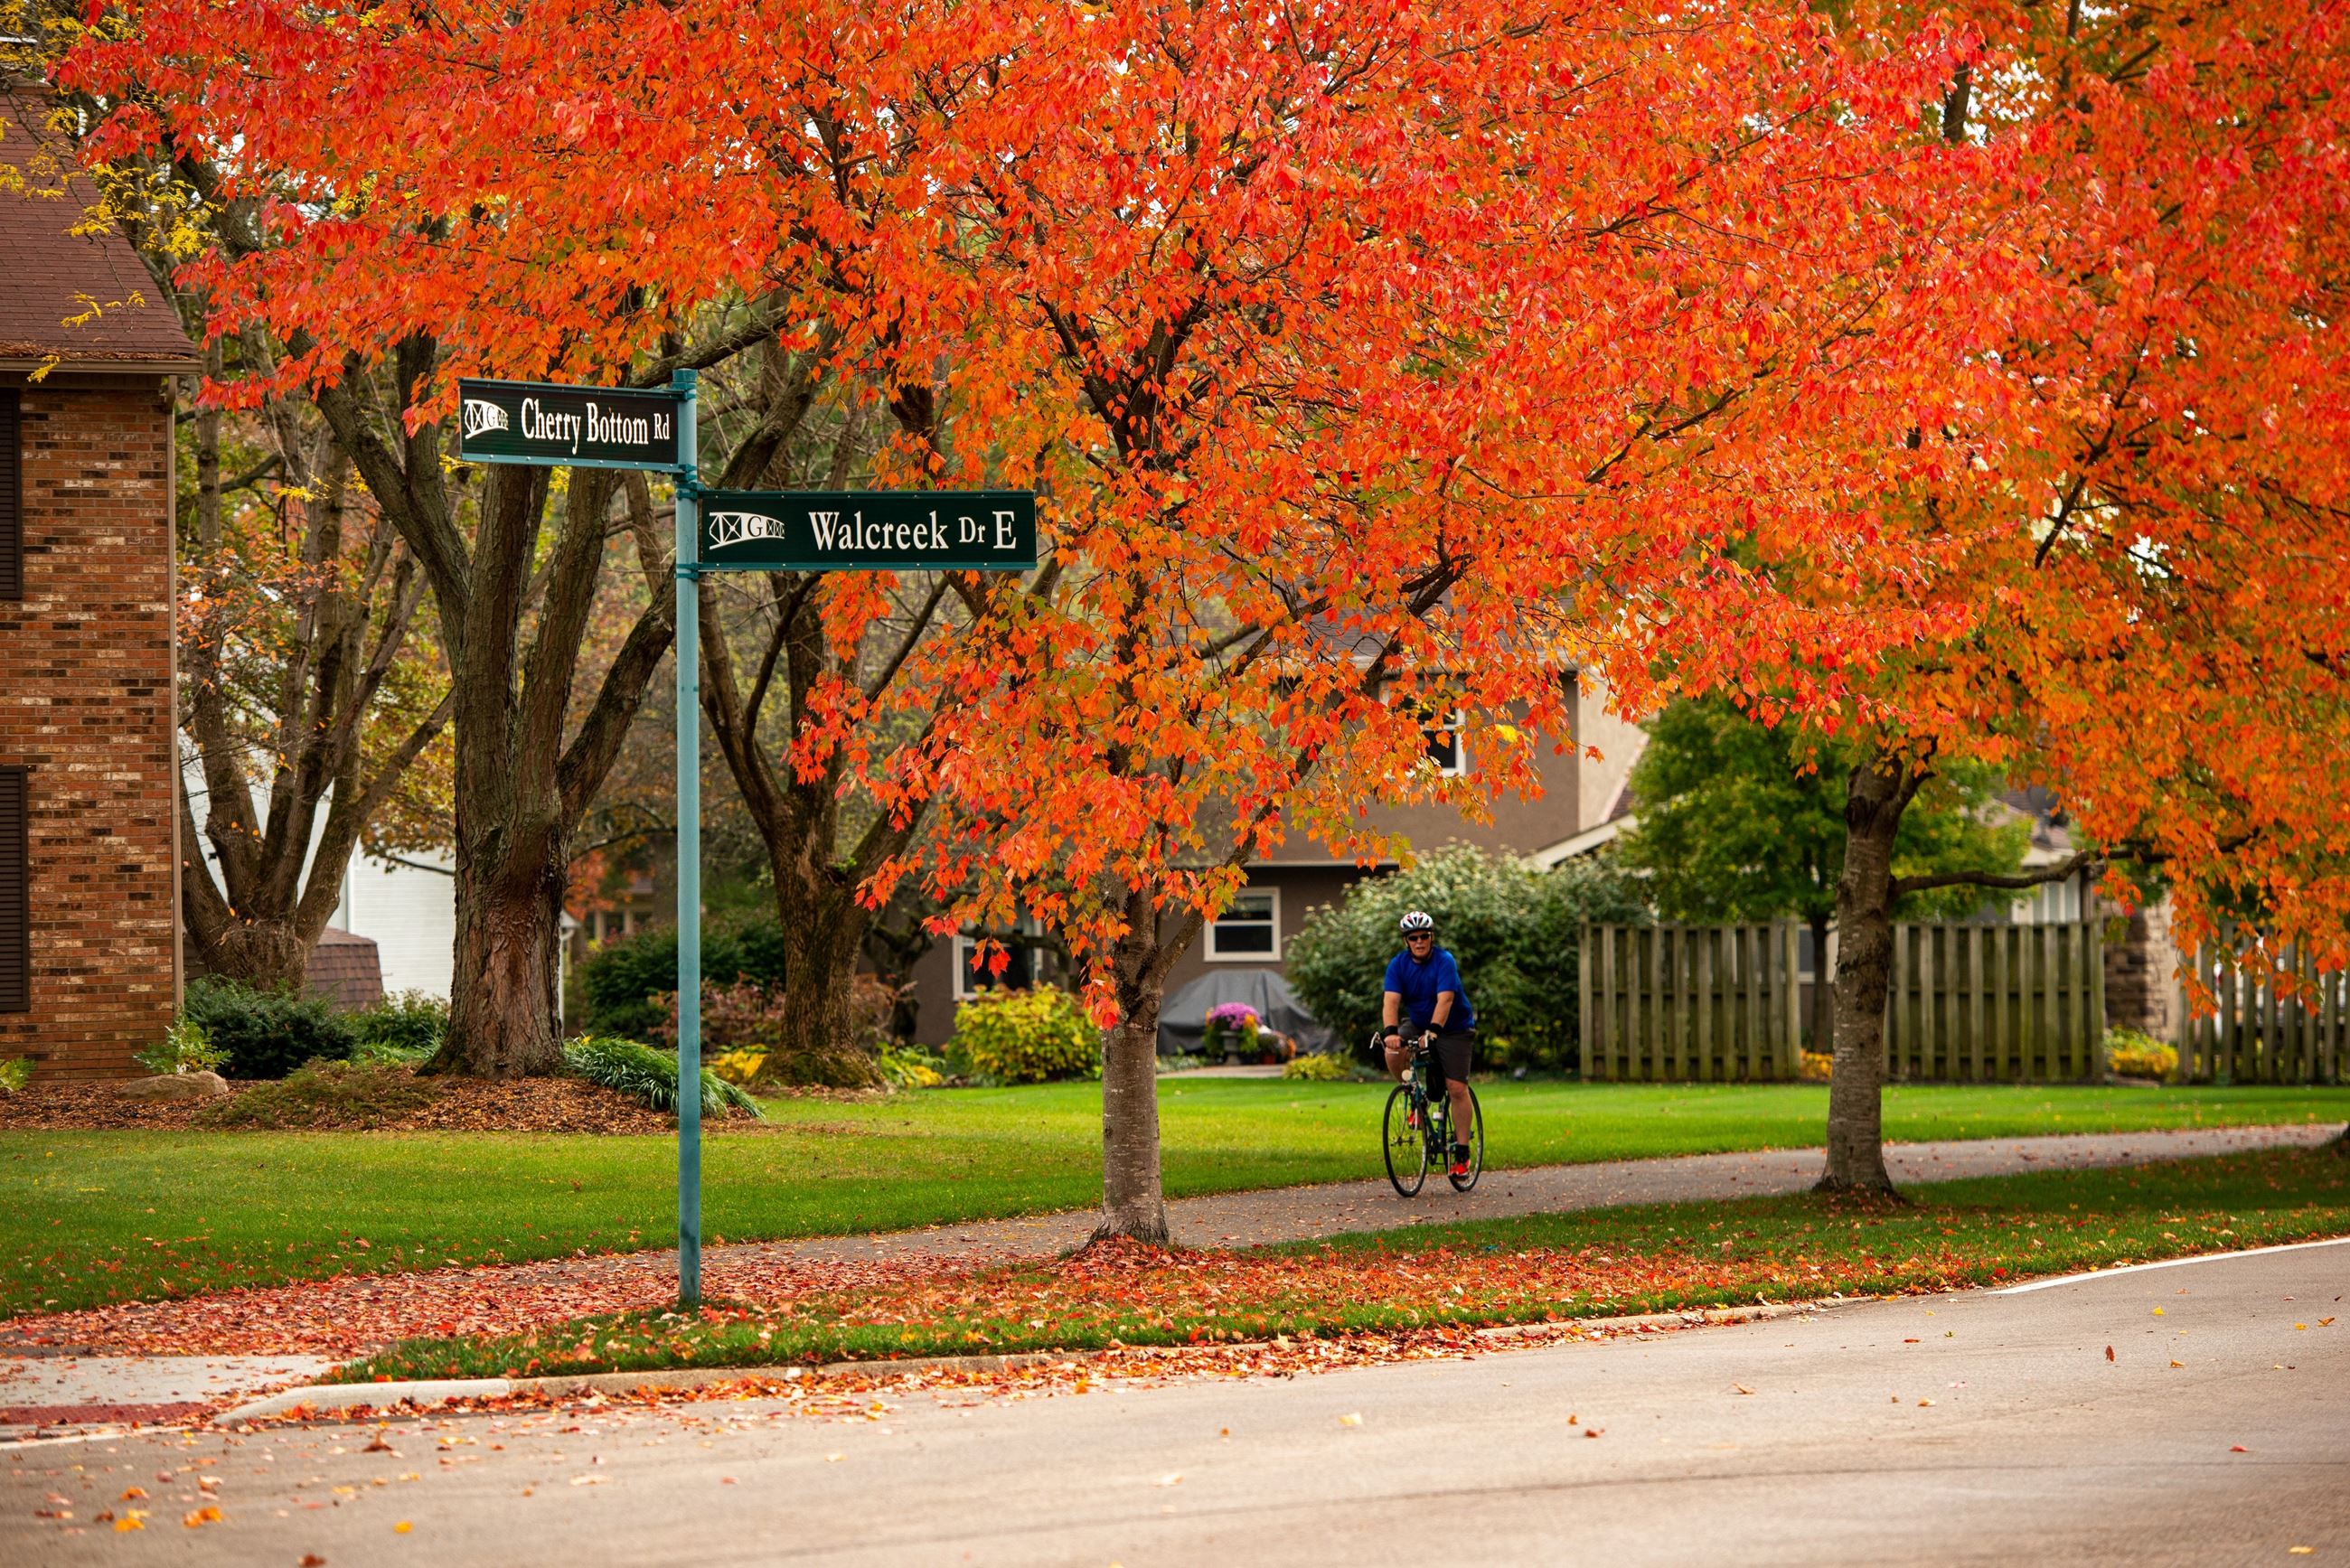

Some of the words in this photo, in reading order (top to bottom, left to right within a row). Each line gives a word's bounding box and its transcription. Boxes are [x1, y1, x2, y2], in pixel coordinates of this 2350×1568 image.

[486, 405, 495, 427] G
[522, 398, 581, 455] Cherry
[586, 402, 649, 445] Bottom
[653, 413, 671, 440] Rd
[747, 516, 763, 537] G
[808, 511, 949, 550] Walcreek
[958, 517, 985, 543] Dr
[992, 511, 1017, 549] E
